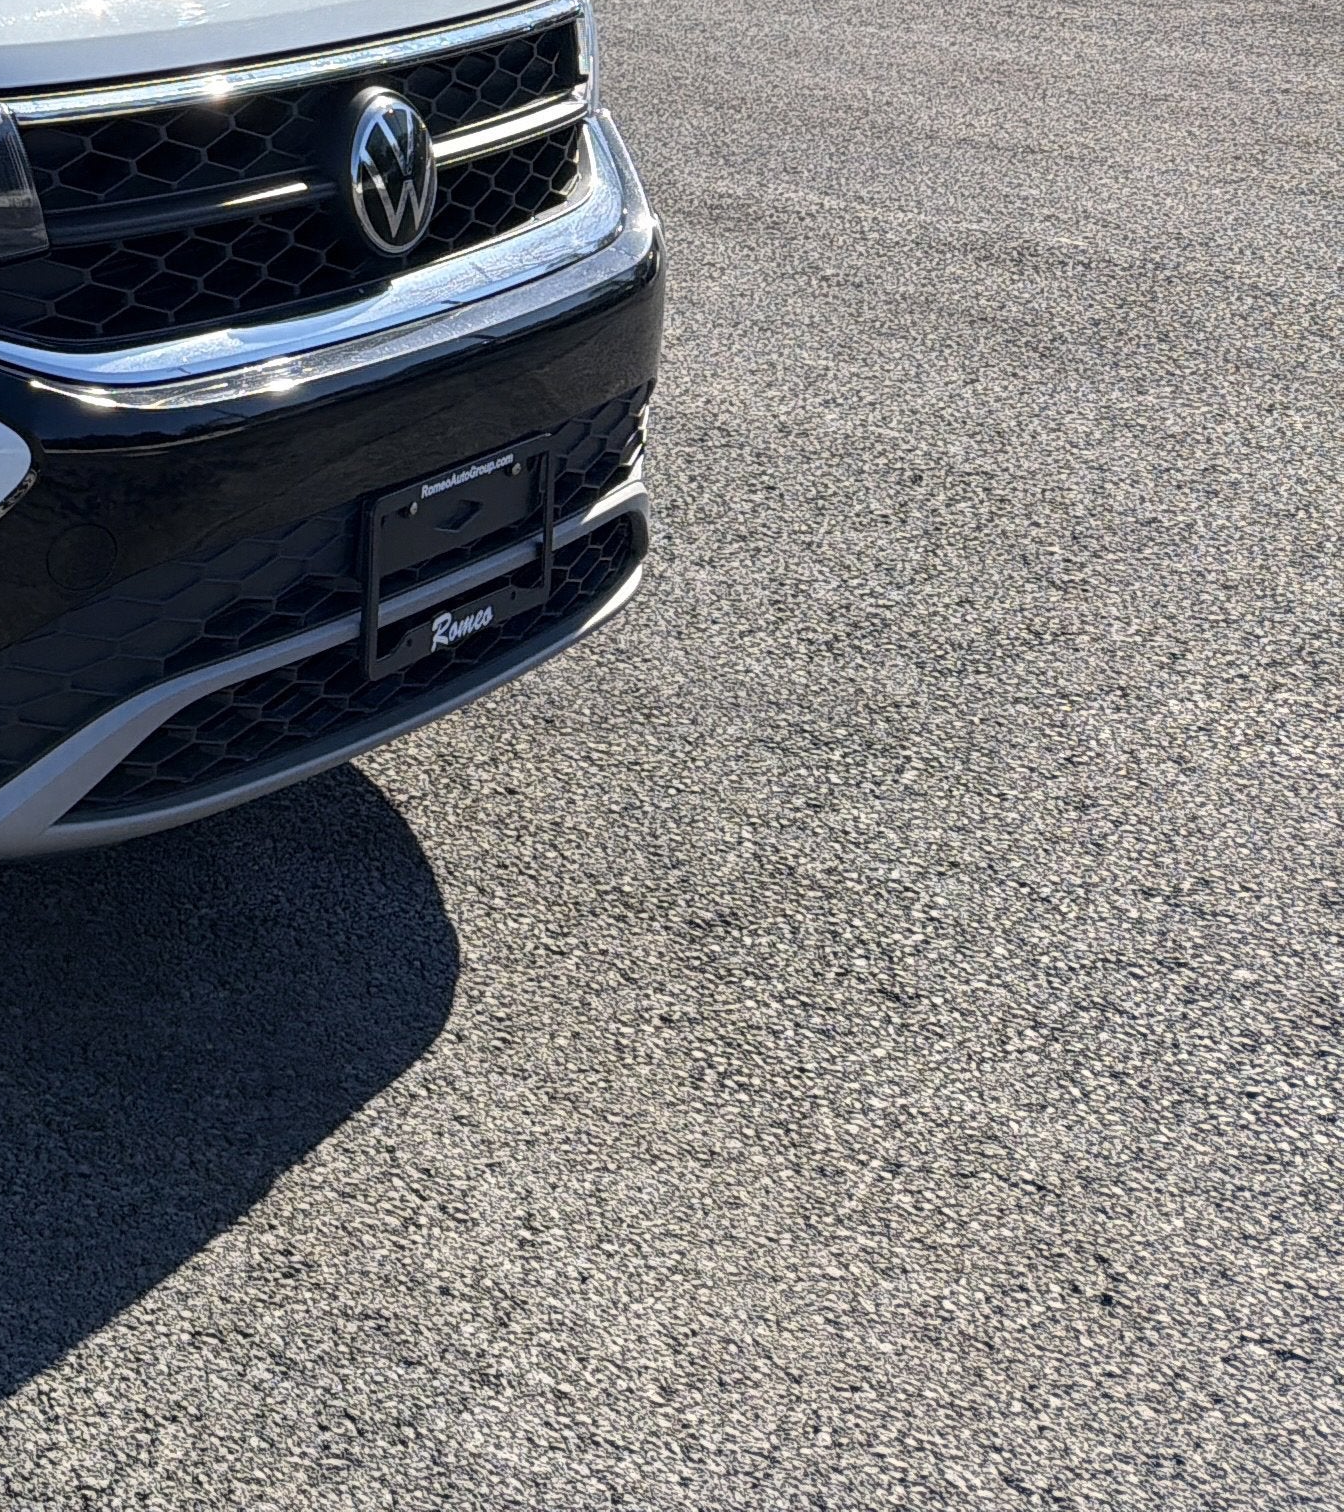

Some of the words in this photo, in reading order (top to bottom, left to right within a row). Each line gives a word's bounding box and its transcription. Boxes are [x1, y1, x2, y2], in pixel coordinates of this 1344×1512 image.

[354, 94, 436, 247] VW
[421, 453, 514, 499] RomeoAutoGroup.com
[430, 606, 494, 653] Romeo
